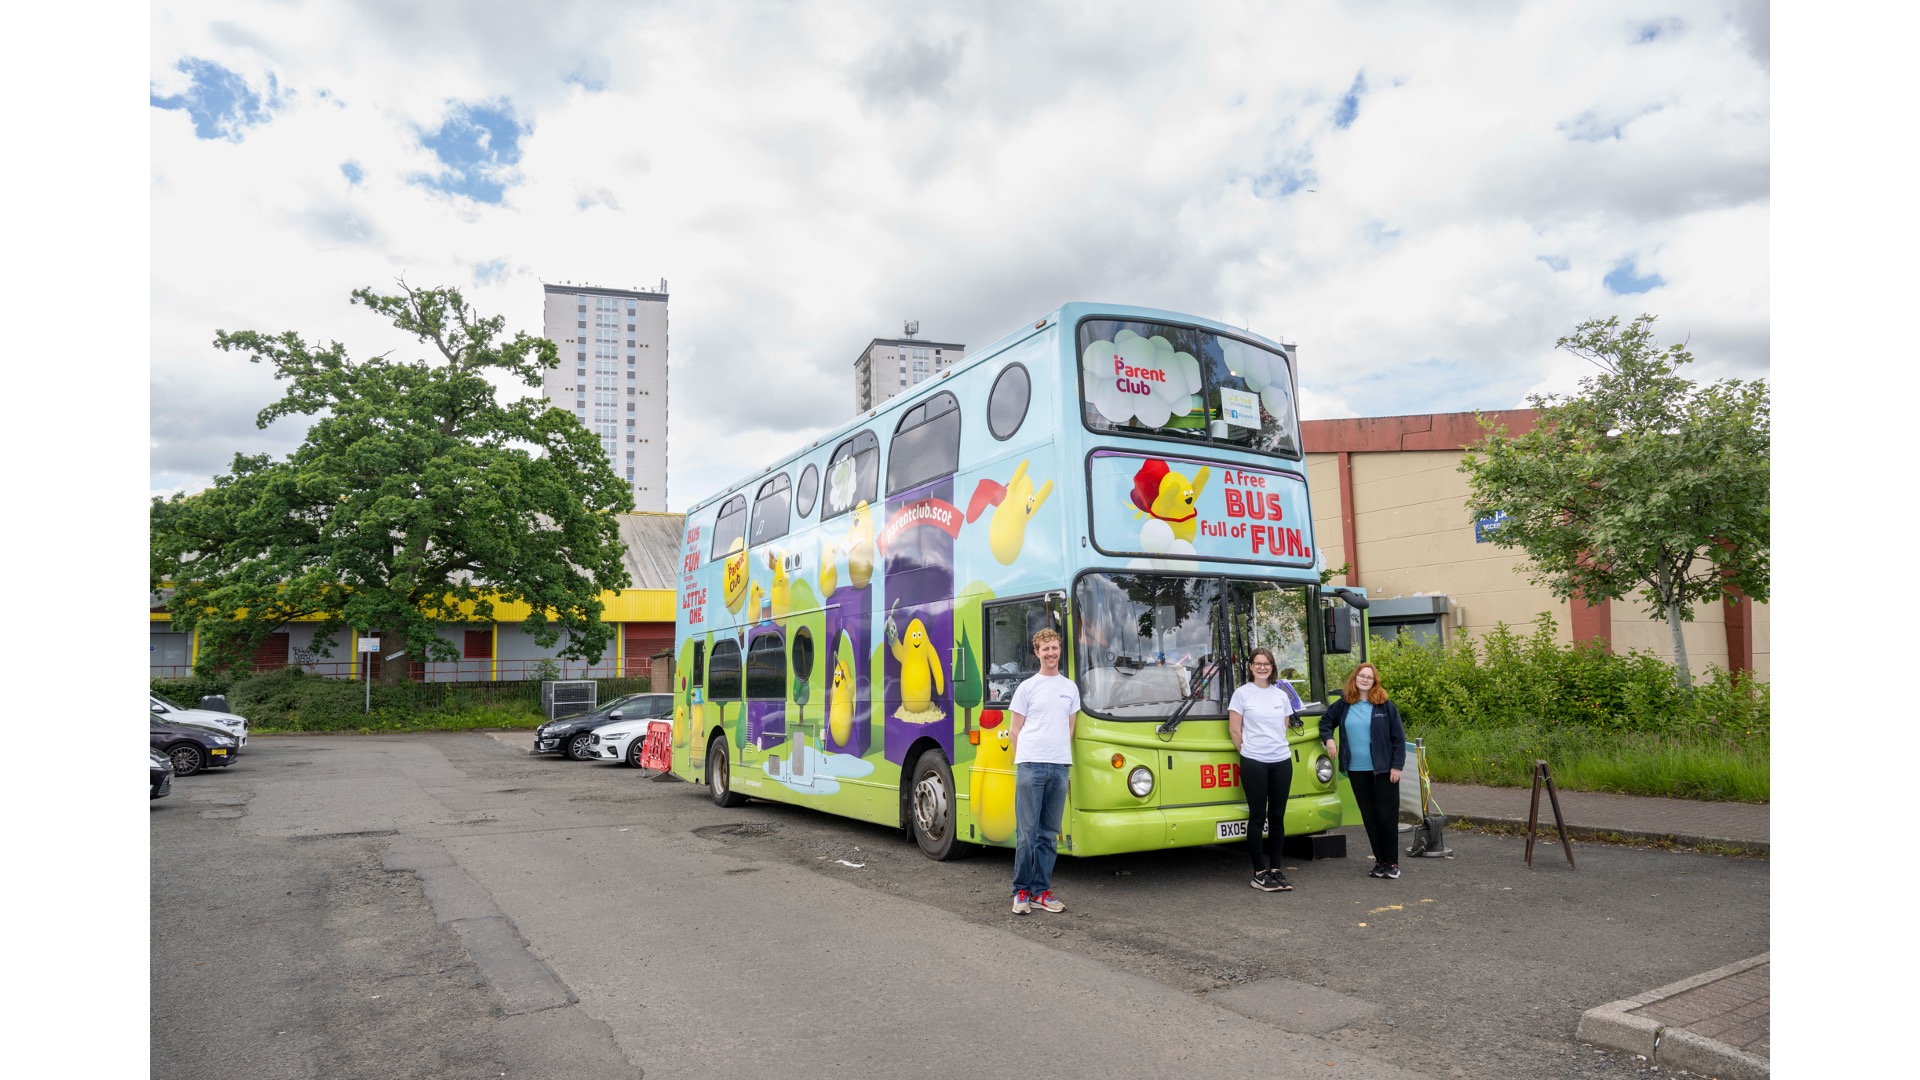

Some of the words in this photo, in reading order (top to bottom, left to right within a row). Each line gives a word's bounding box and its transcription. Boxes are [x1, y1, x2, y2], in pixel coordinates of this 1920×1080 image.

[1114, 355, 1166, 382] Parent
[1116, 378, 1151, 396] Club
[1224, 470, 1234, 485] A
[1237, 470, 1266, 488] free
[1225, 488, 1282, 521] BUS
[687, 526, 700, 545] BUS
[887, 503, 952, 544] parentclub.scot
[1201, 520, 1227, 537] full
[1231, 523, 1246, 538] of
[1250, 524, 1311, 558] FUN.
[684, 550, 701, 574] FUN
[728, 552, 744, 580] Parent
[730, 574, 741, 592] Club
[683, 588, 707, 609] LITTLE
